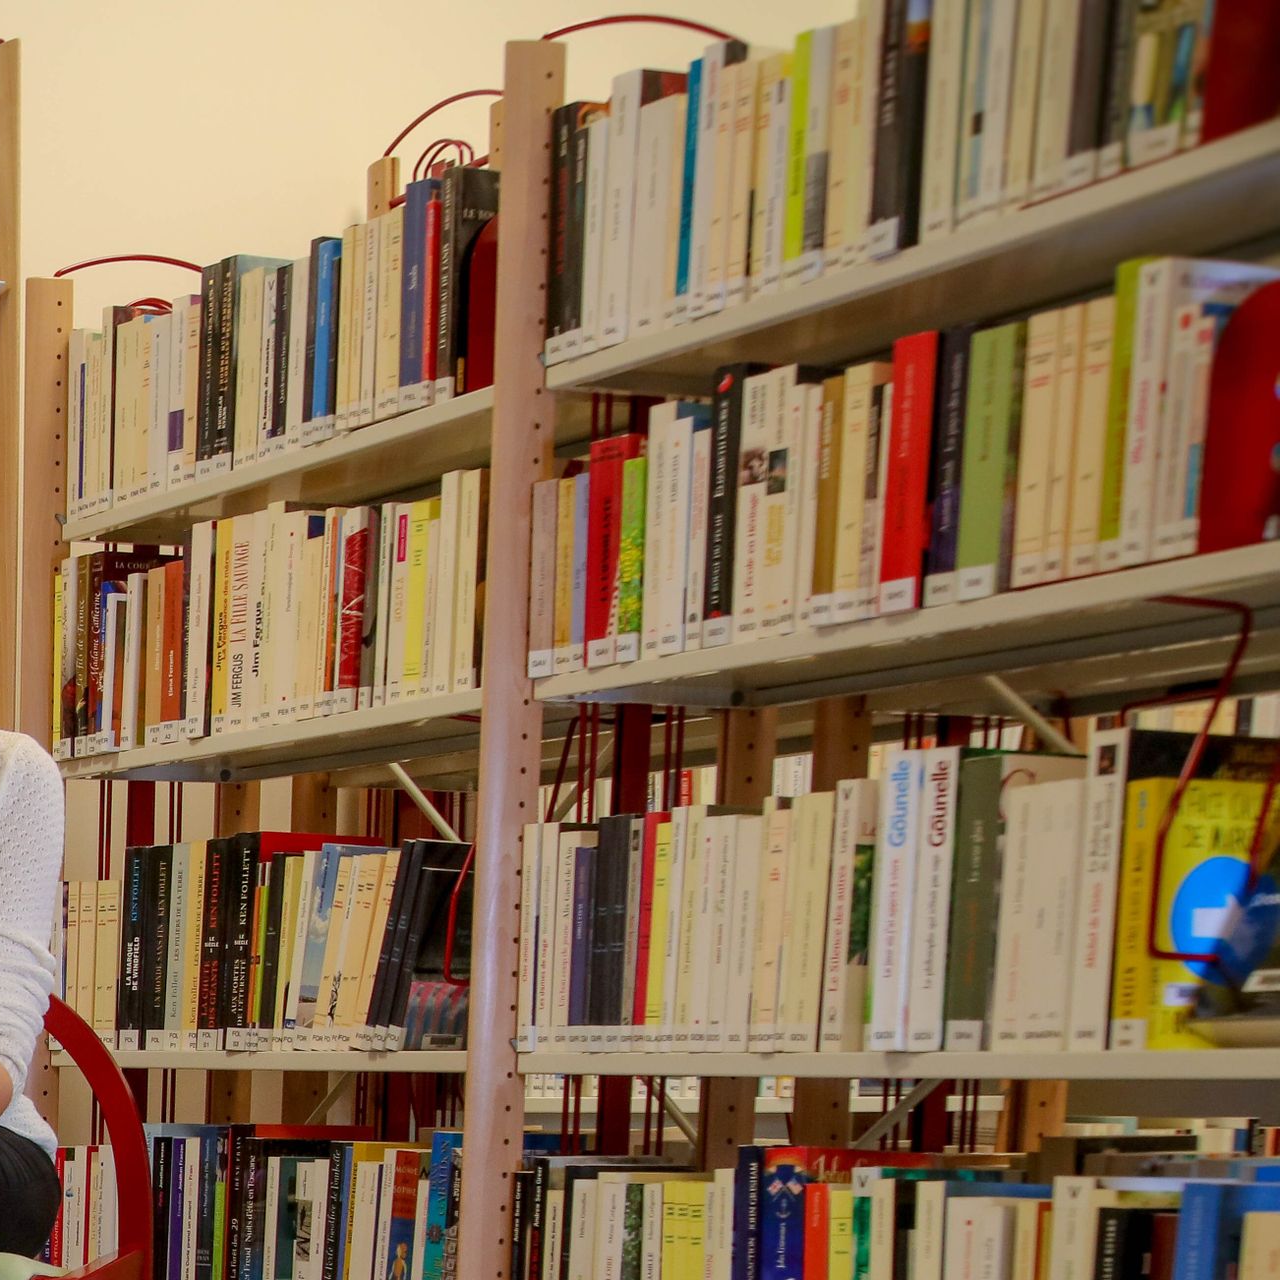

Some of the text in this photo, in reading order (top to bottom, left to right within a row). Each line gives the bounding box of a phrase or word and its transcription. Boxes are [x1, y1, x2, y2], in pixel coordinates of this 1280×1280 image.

[232, 654, 243, 708] JIM FERGUS
[887, 758, 913, 849] Gounelle
[928, 759, 951, 849] Gounelle
[240, 848, 251, 909] FOLLETT
[126, 977, 132, 986] LA
[132, 981, 137, 990] DE
